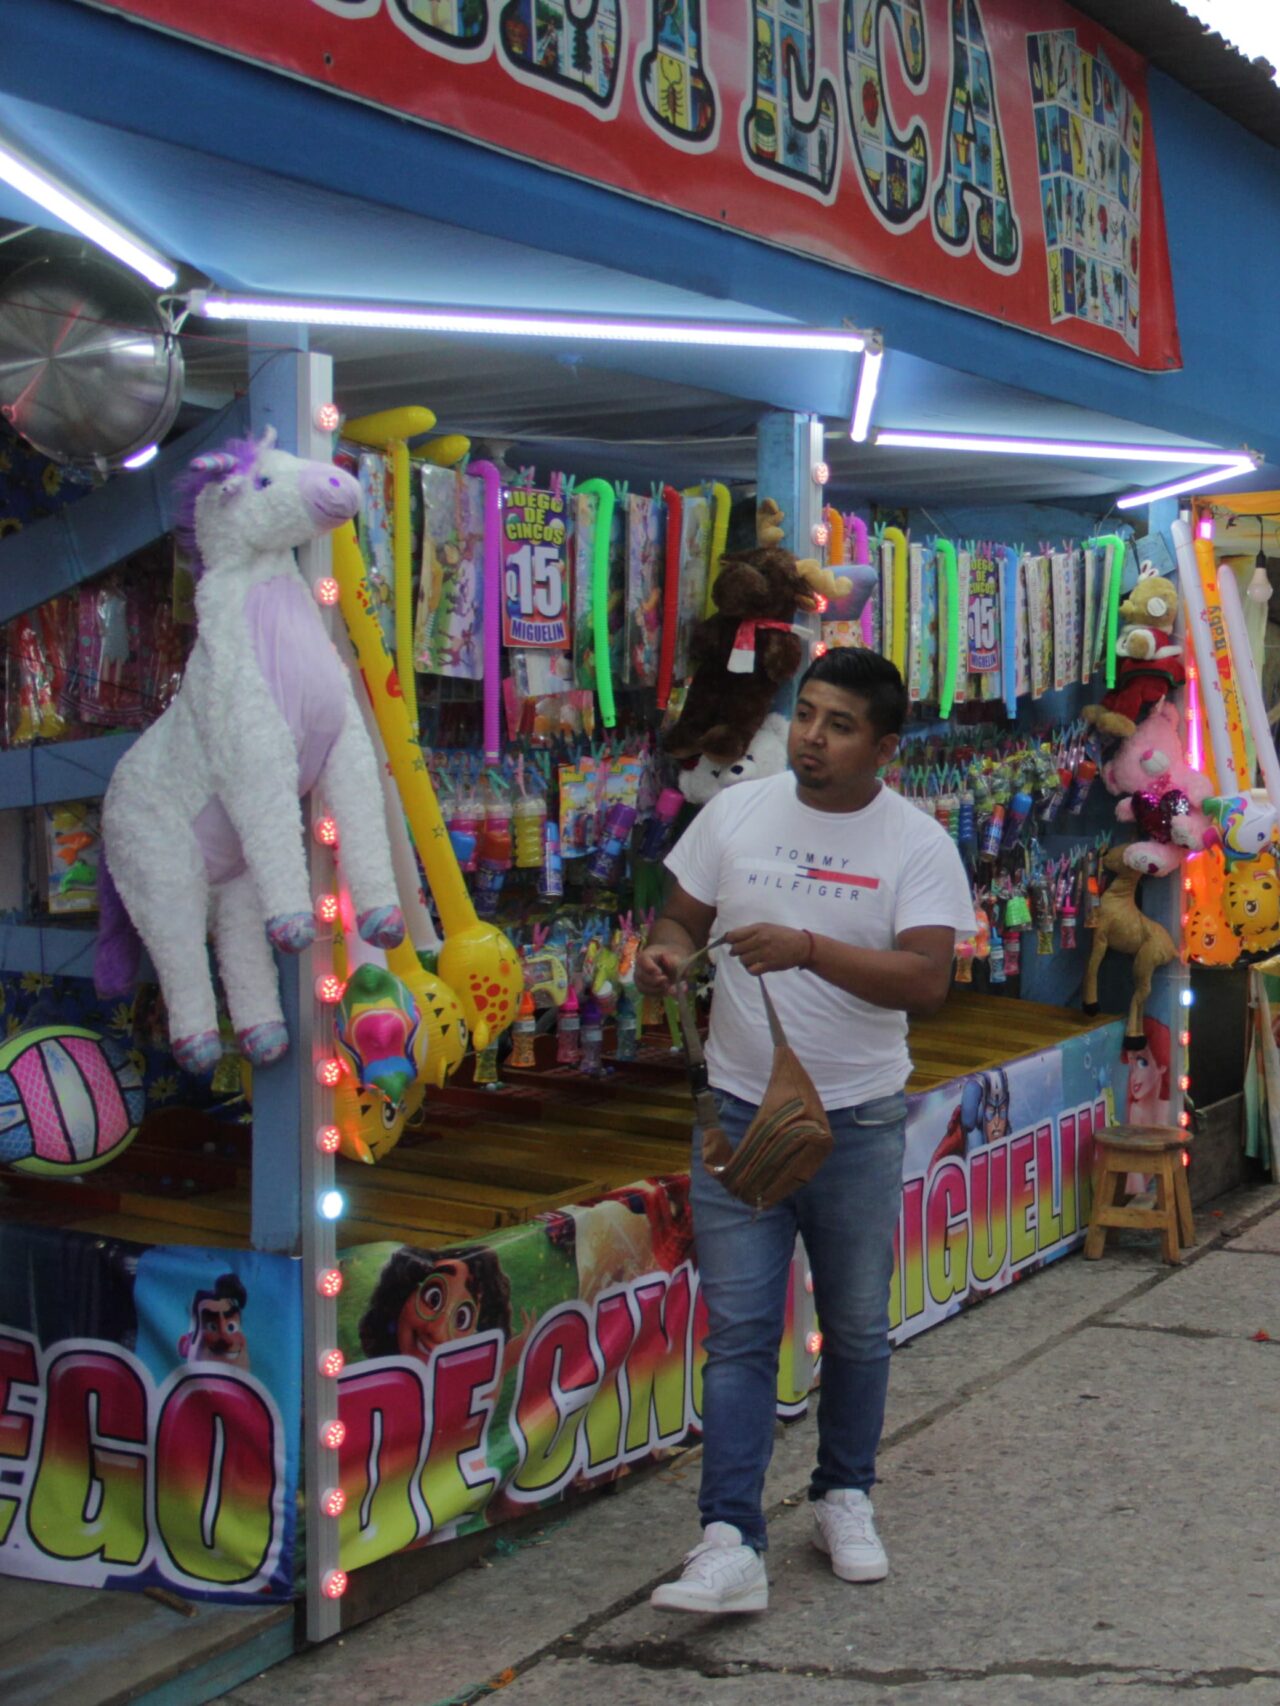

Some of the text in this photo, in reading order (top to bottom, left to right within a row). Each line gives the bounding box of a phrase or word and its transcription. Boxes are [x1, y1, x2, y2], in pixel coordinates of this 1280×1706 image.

[508, 491, 563, 513] JUEGO
[525, 507, 546, 525] DE
[507, 523, 564, 544] CINCOS
[511, 619, 565, 642] MIGUELIN
[774, 846, 850, 869] TOMMY
[748, 874, 860, 901] HILFIGER
